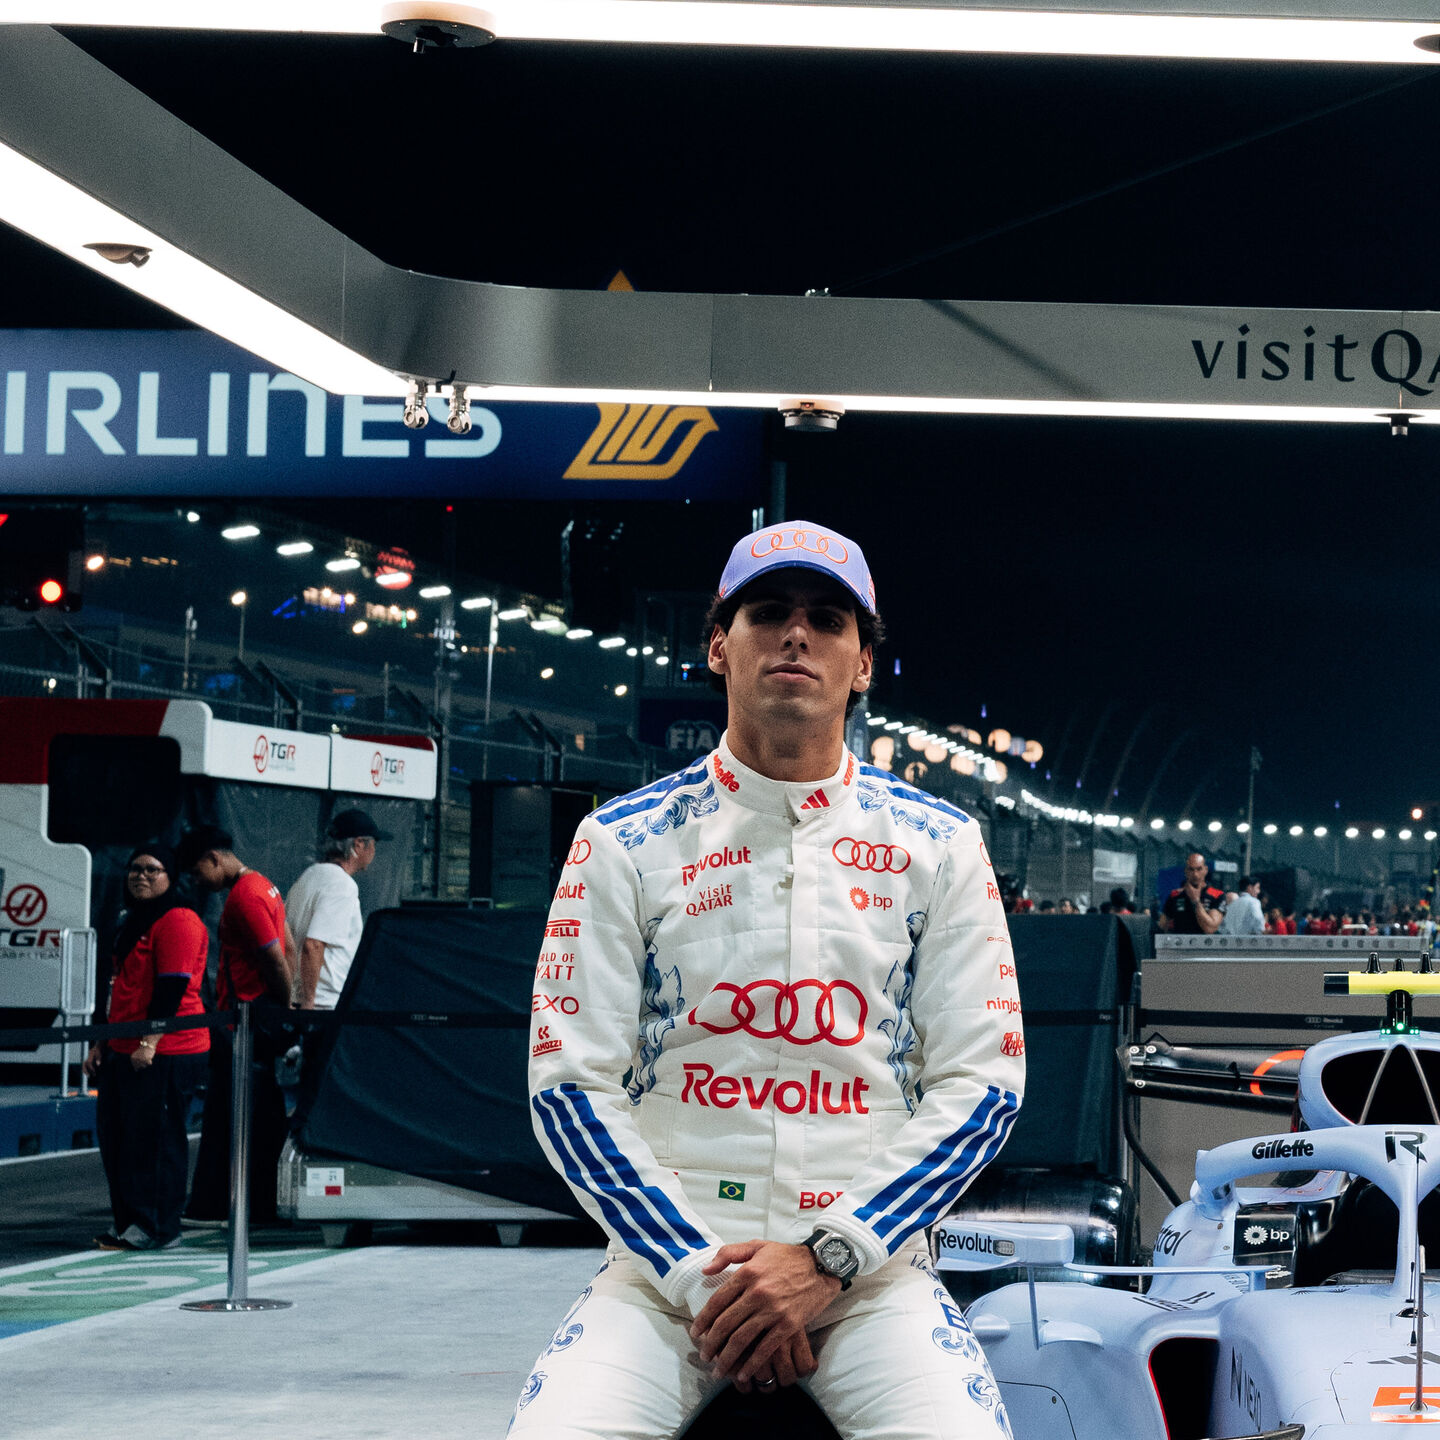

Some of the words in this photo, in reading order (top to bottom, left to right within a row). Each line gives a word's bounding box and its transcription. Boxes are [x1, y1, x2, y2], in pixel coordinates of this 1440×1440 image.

[4, 371, 502, 459] IRLINES
[271, 742, 296, 760] TGR
[384, 758, 405, 774] TGR
[682, 846, 751, 886] Revolut
[555, 881, 586, 900] olut
[699, 884, 733, 900] visit
[686, 894, 733, 916] QATAR
[873, 893, 893, 912] bp
[545, 919, 581, 937] RELLI
[535, 964, 575, 980] YATT
[531, 994, 579, 1015] EXO
[986, 997, 1022, 1014] ninja
[532, 1040, 562, 1055] CAMOZZI
[681, 1063, 870, 1115] Revolut
[1252, 1139, 1314, 1159] Gillette
[799, 1191, 845, 1209] BO
[940, 1228, 993, 1254] Revolut
[1270, 1228, 1290, 1243] bp
